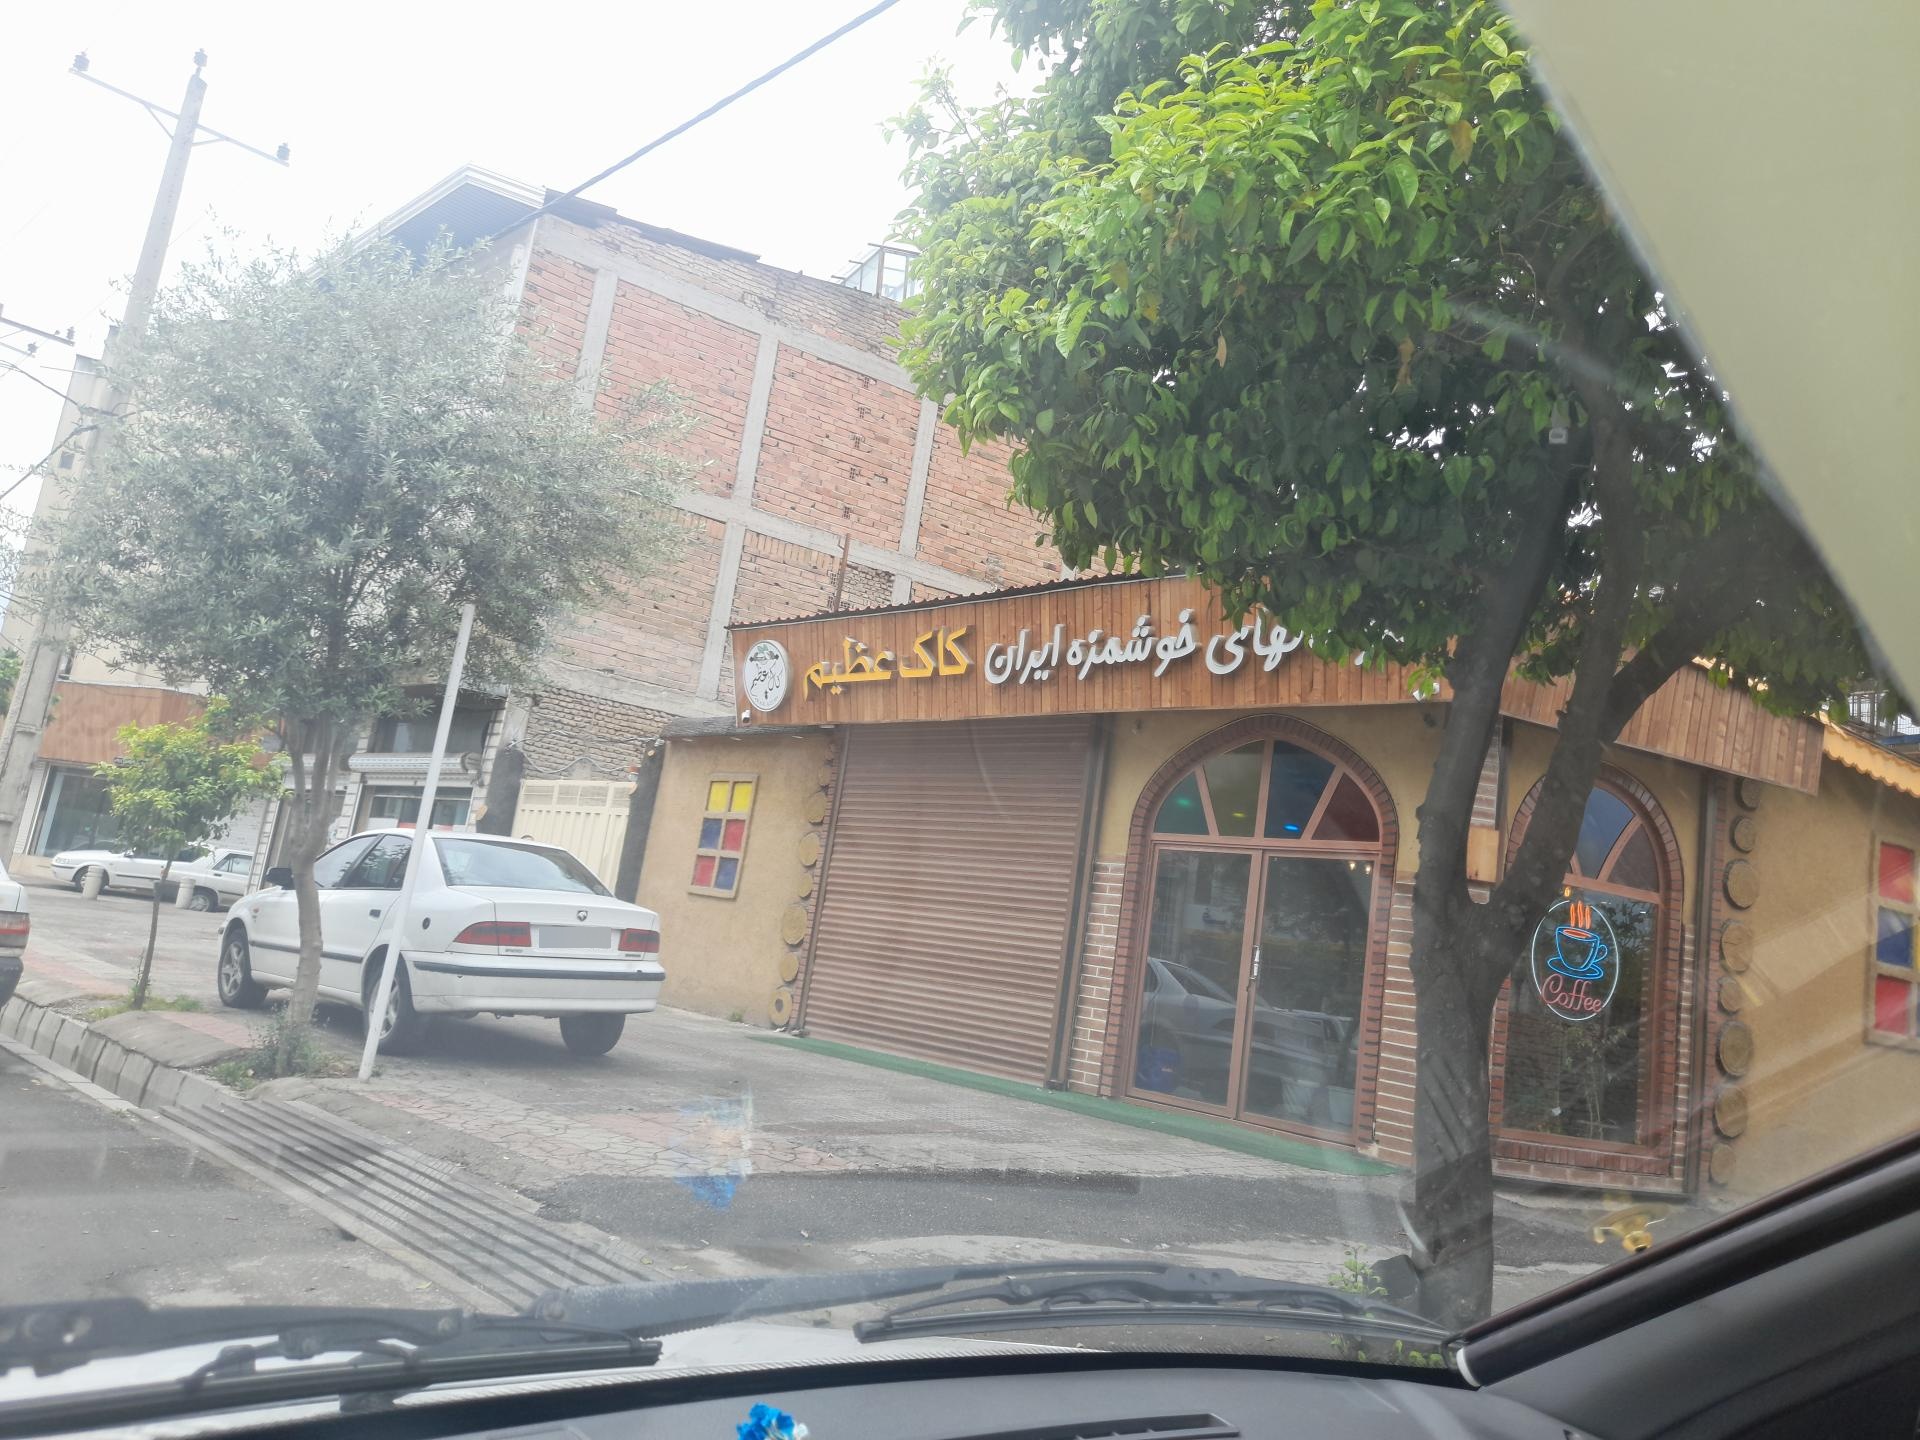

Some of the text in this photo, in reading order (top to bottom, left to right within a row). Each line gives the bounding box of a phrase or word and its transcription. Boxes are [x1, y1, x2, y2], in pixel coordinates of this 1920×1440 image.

[803, 638, 893, 700] عظیم
[899, 625, 973, 678] کاک
[984, 625, 1065, 684] ایران
[1066, 609, 1195, 680] خوشمزه
[1542, 973, 1602, 1012] Coffee
